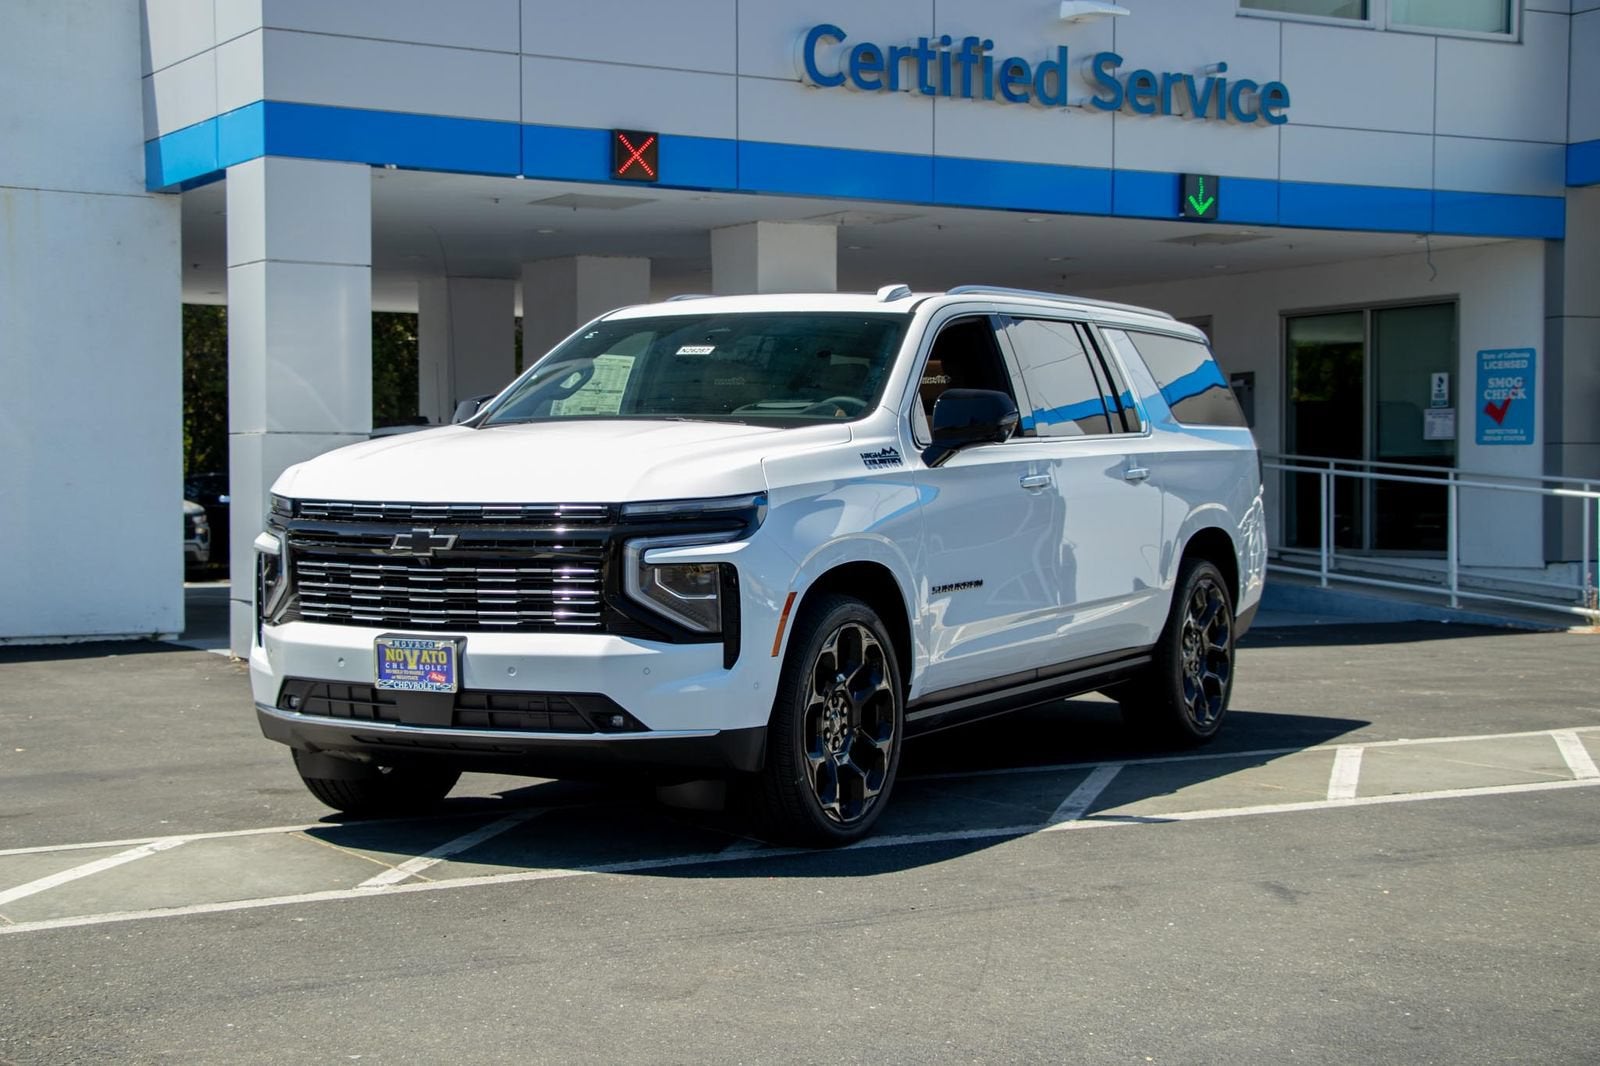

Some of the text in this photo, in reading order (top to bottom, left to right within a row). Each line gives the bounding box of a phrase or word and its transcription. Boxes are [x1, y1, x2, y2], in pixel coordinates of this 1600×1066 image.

[803, 23, 1291, 126] Certified Service
[1484, 360, 1528, 369] LICENSED
[1488, 377, 1523, 388] SMOG
[1484, 389, 1527, 400] CHECK
[863, 457, 902, 466] COUNTRY
[931, 579, 984, 594] SUBURBAN
[393, 640, 434, 648] NOVATO
[385, 648, 447, 669] NOVATO
[393, 680, 436, 690] CHEVROLET
